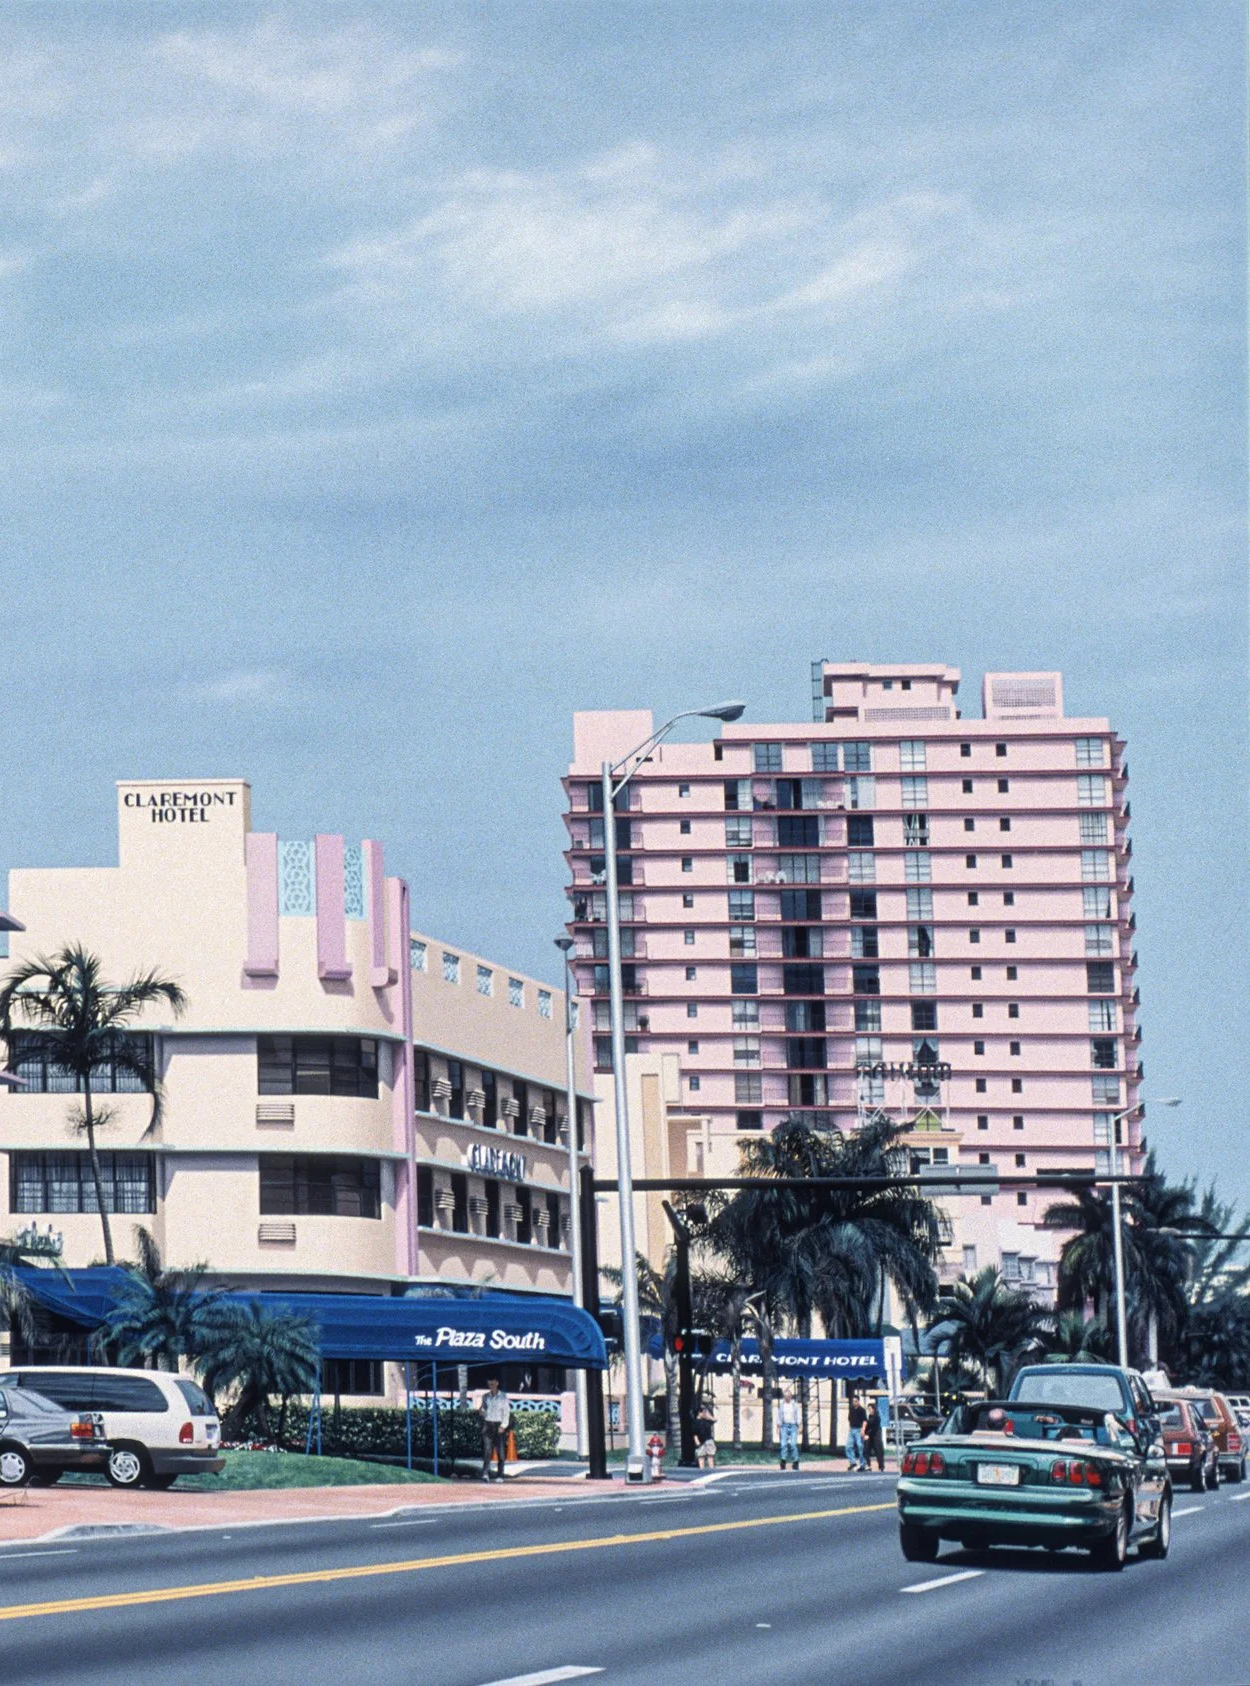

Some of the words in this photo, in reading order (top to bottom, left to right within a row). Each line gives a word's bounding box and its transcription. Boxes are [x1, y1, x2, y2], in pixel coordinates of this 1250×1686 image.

[124, 791, 237, 807] CLAREMONT
[151, 808, 210, 823] HOTEL
[415, 1335, 433, 1346] The
[435, 1327, 486, 1348] Plaza
[489, 1329, 545, 1350] South
[715, 1352, 821, 1367] CLARMONT
[823, 1355, 878, 1367] HOTEL
